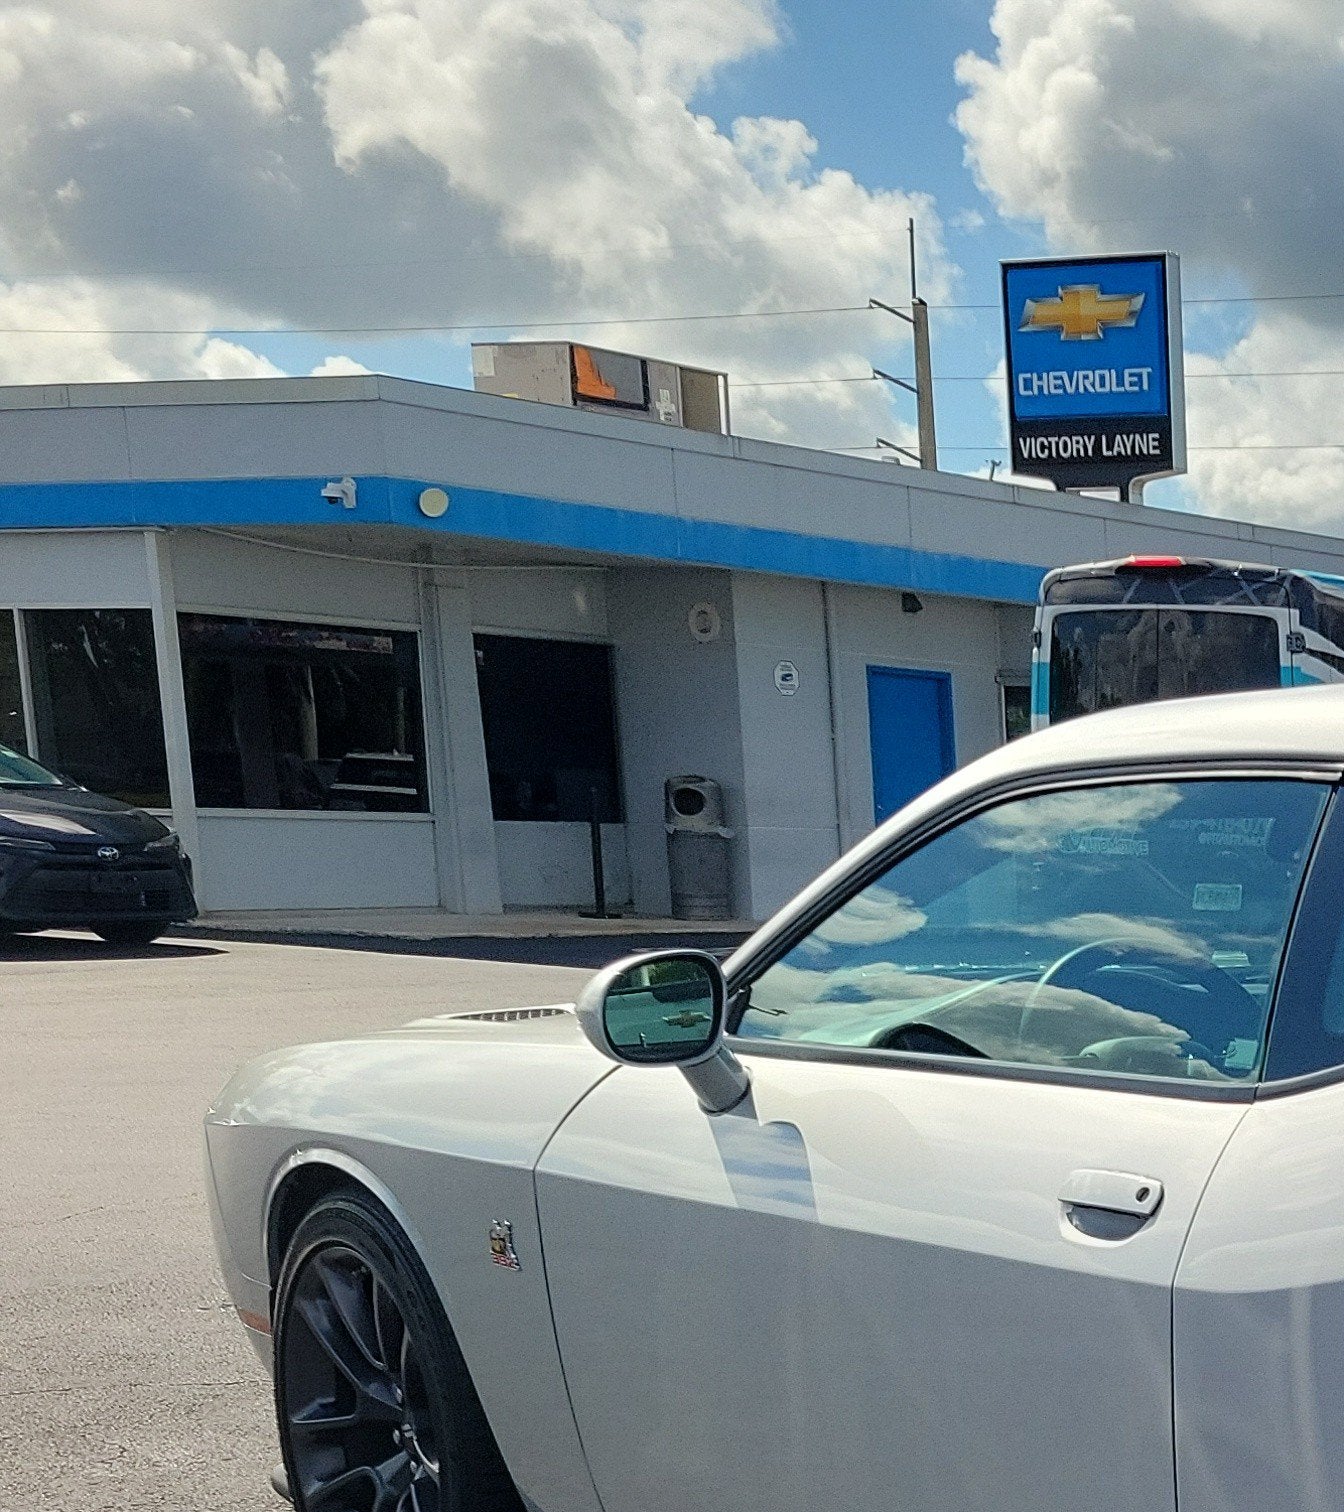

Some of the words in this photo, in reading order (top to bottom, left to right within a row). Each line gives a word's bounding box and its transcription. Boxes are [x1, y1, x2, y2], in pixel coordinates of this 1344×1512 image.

[1018, 367, 1152, 396] CHEVROLET
[1019, 435, 1095, 458] VICTORY
[1101, 433, 1160, 457] LAYNE
